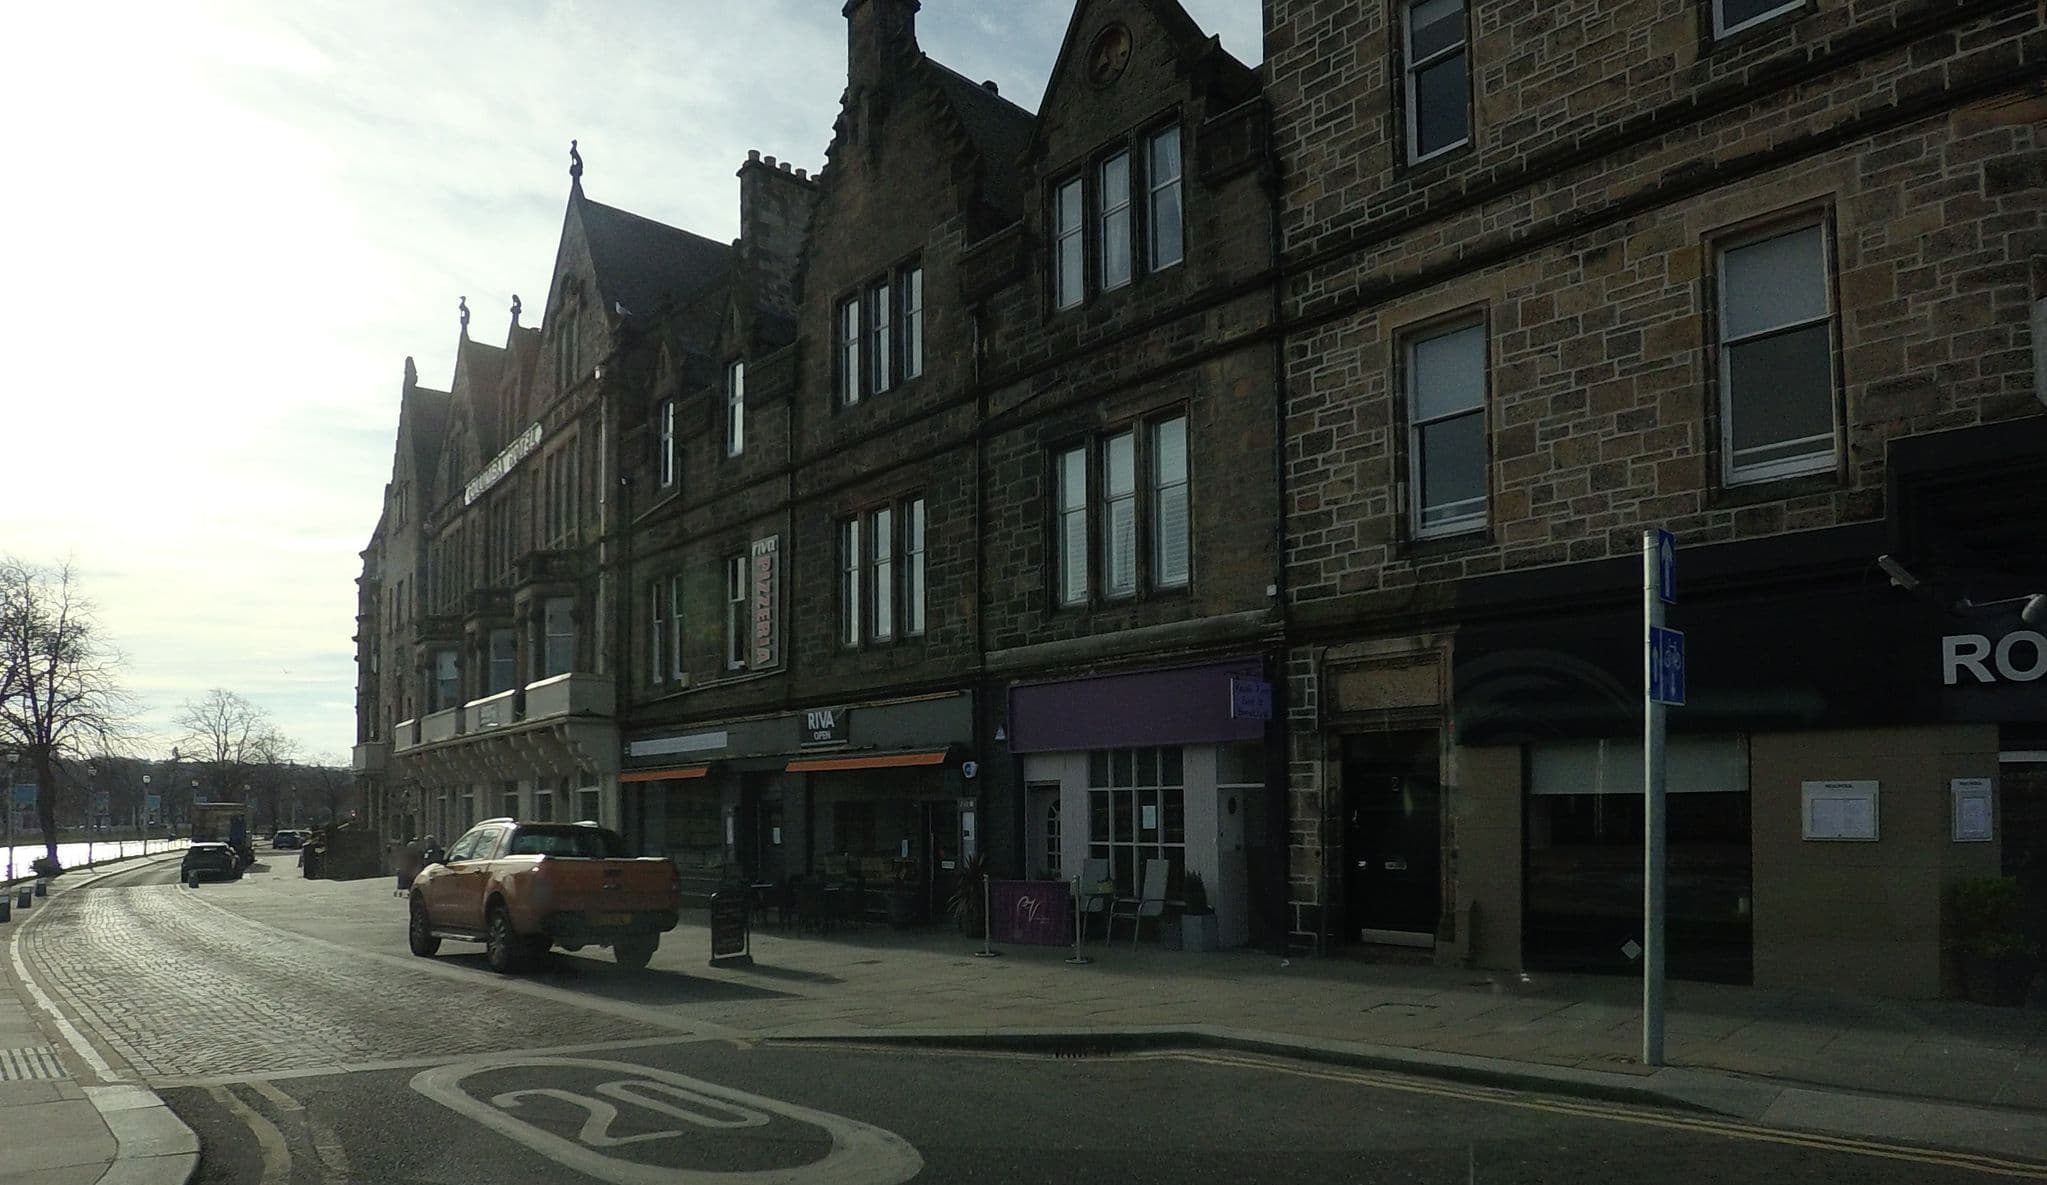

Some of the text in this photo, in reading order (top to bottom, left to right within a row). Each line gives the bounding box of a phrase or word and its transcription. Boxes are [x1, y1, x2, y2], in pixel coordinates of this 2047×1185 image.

[756, 555, 773, 664] PIZZERIA
[1942, 630, 2047, 685] RO
[808, 711, 835, 729] RIVA
[814, 730, 831, 740] OPEN
[490, 1079, 771, 1147] 20
